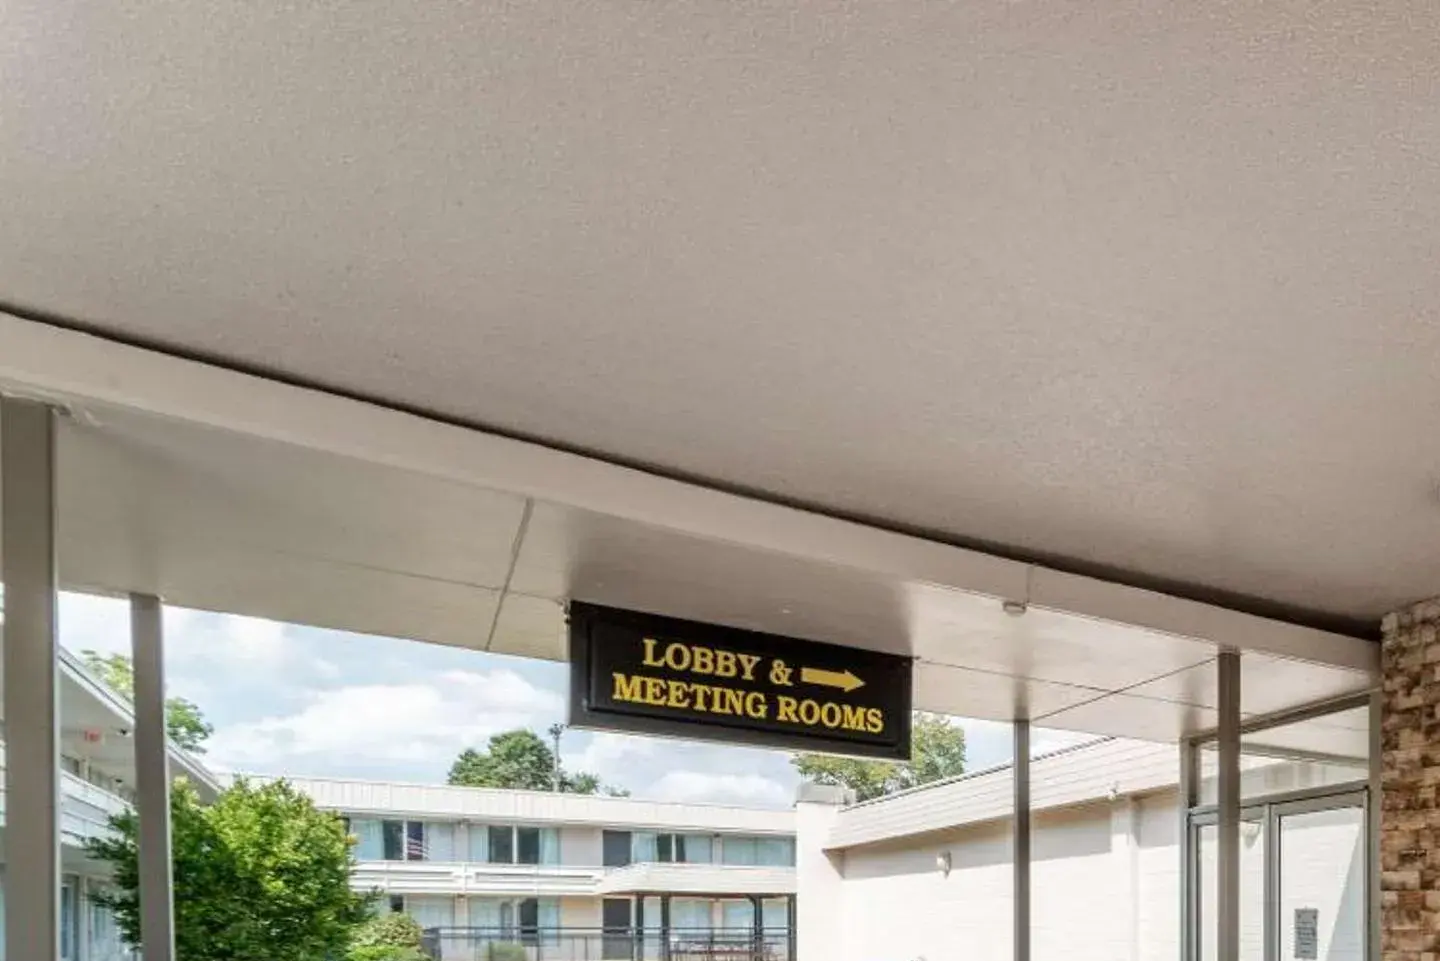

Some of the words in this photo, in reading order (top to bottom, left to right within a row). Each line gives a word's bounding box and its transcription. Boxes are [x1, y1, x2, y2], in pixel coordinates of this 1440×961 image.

[643, 638, 761, 680] LOBBY
[769, 659, 794, 687] &
[612, 672, 767, 719] MEETING
[777, 696, 884, 733] ROOMS
